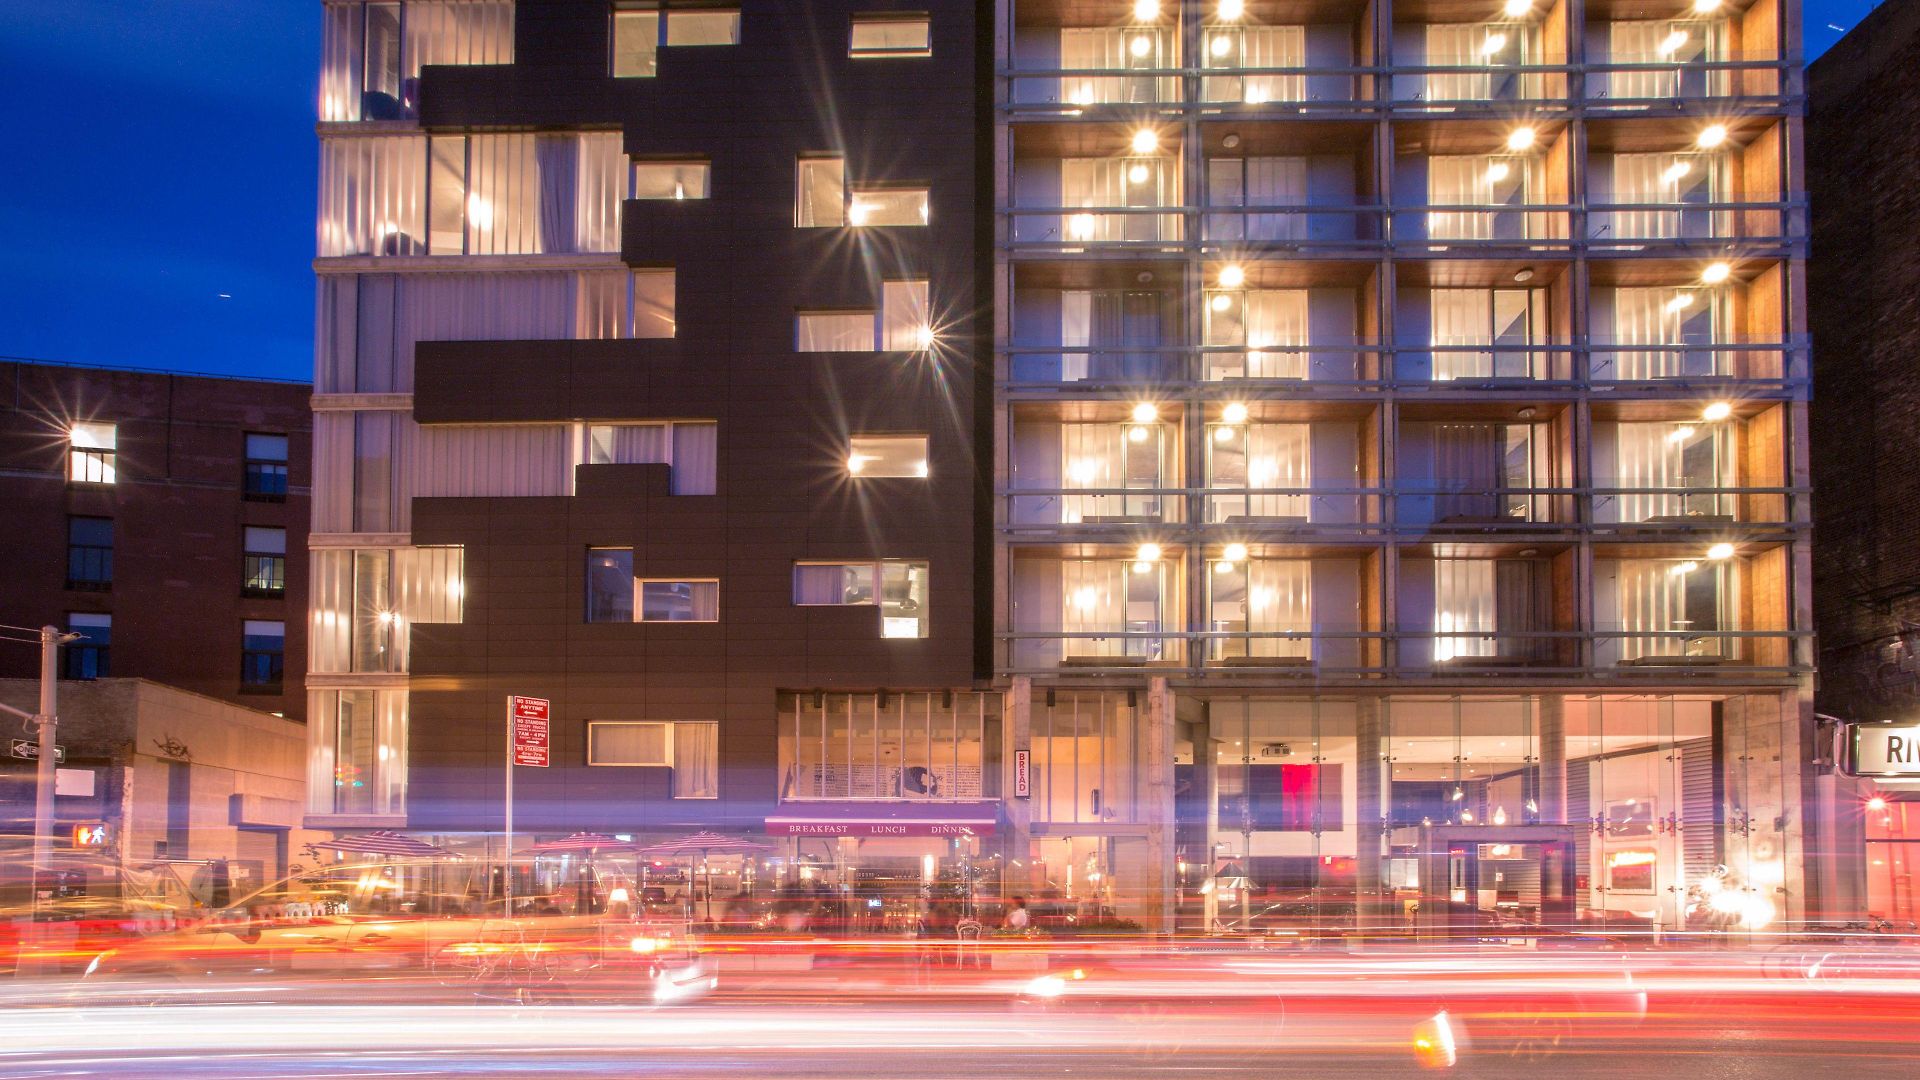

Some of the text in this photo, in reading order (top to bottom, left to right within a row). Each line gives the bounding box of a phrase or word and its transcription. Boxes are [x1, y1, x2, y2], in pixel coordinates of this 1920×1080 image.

[18, 745, 36, 754] ONE
[1887, 735, 1920, 763] RI
[1018, 752, 1026, 792] BREAD
[789, 825, 972, 834] BREAKFAST LUNCH DINNER
